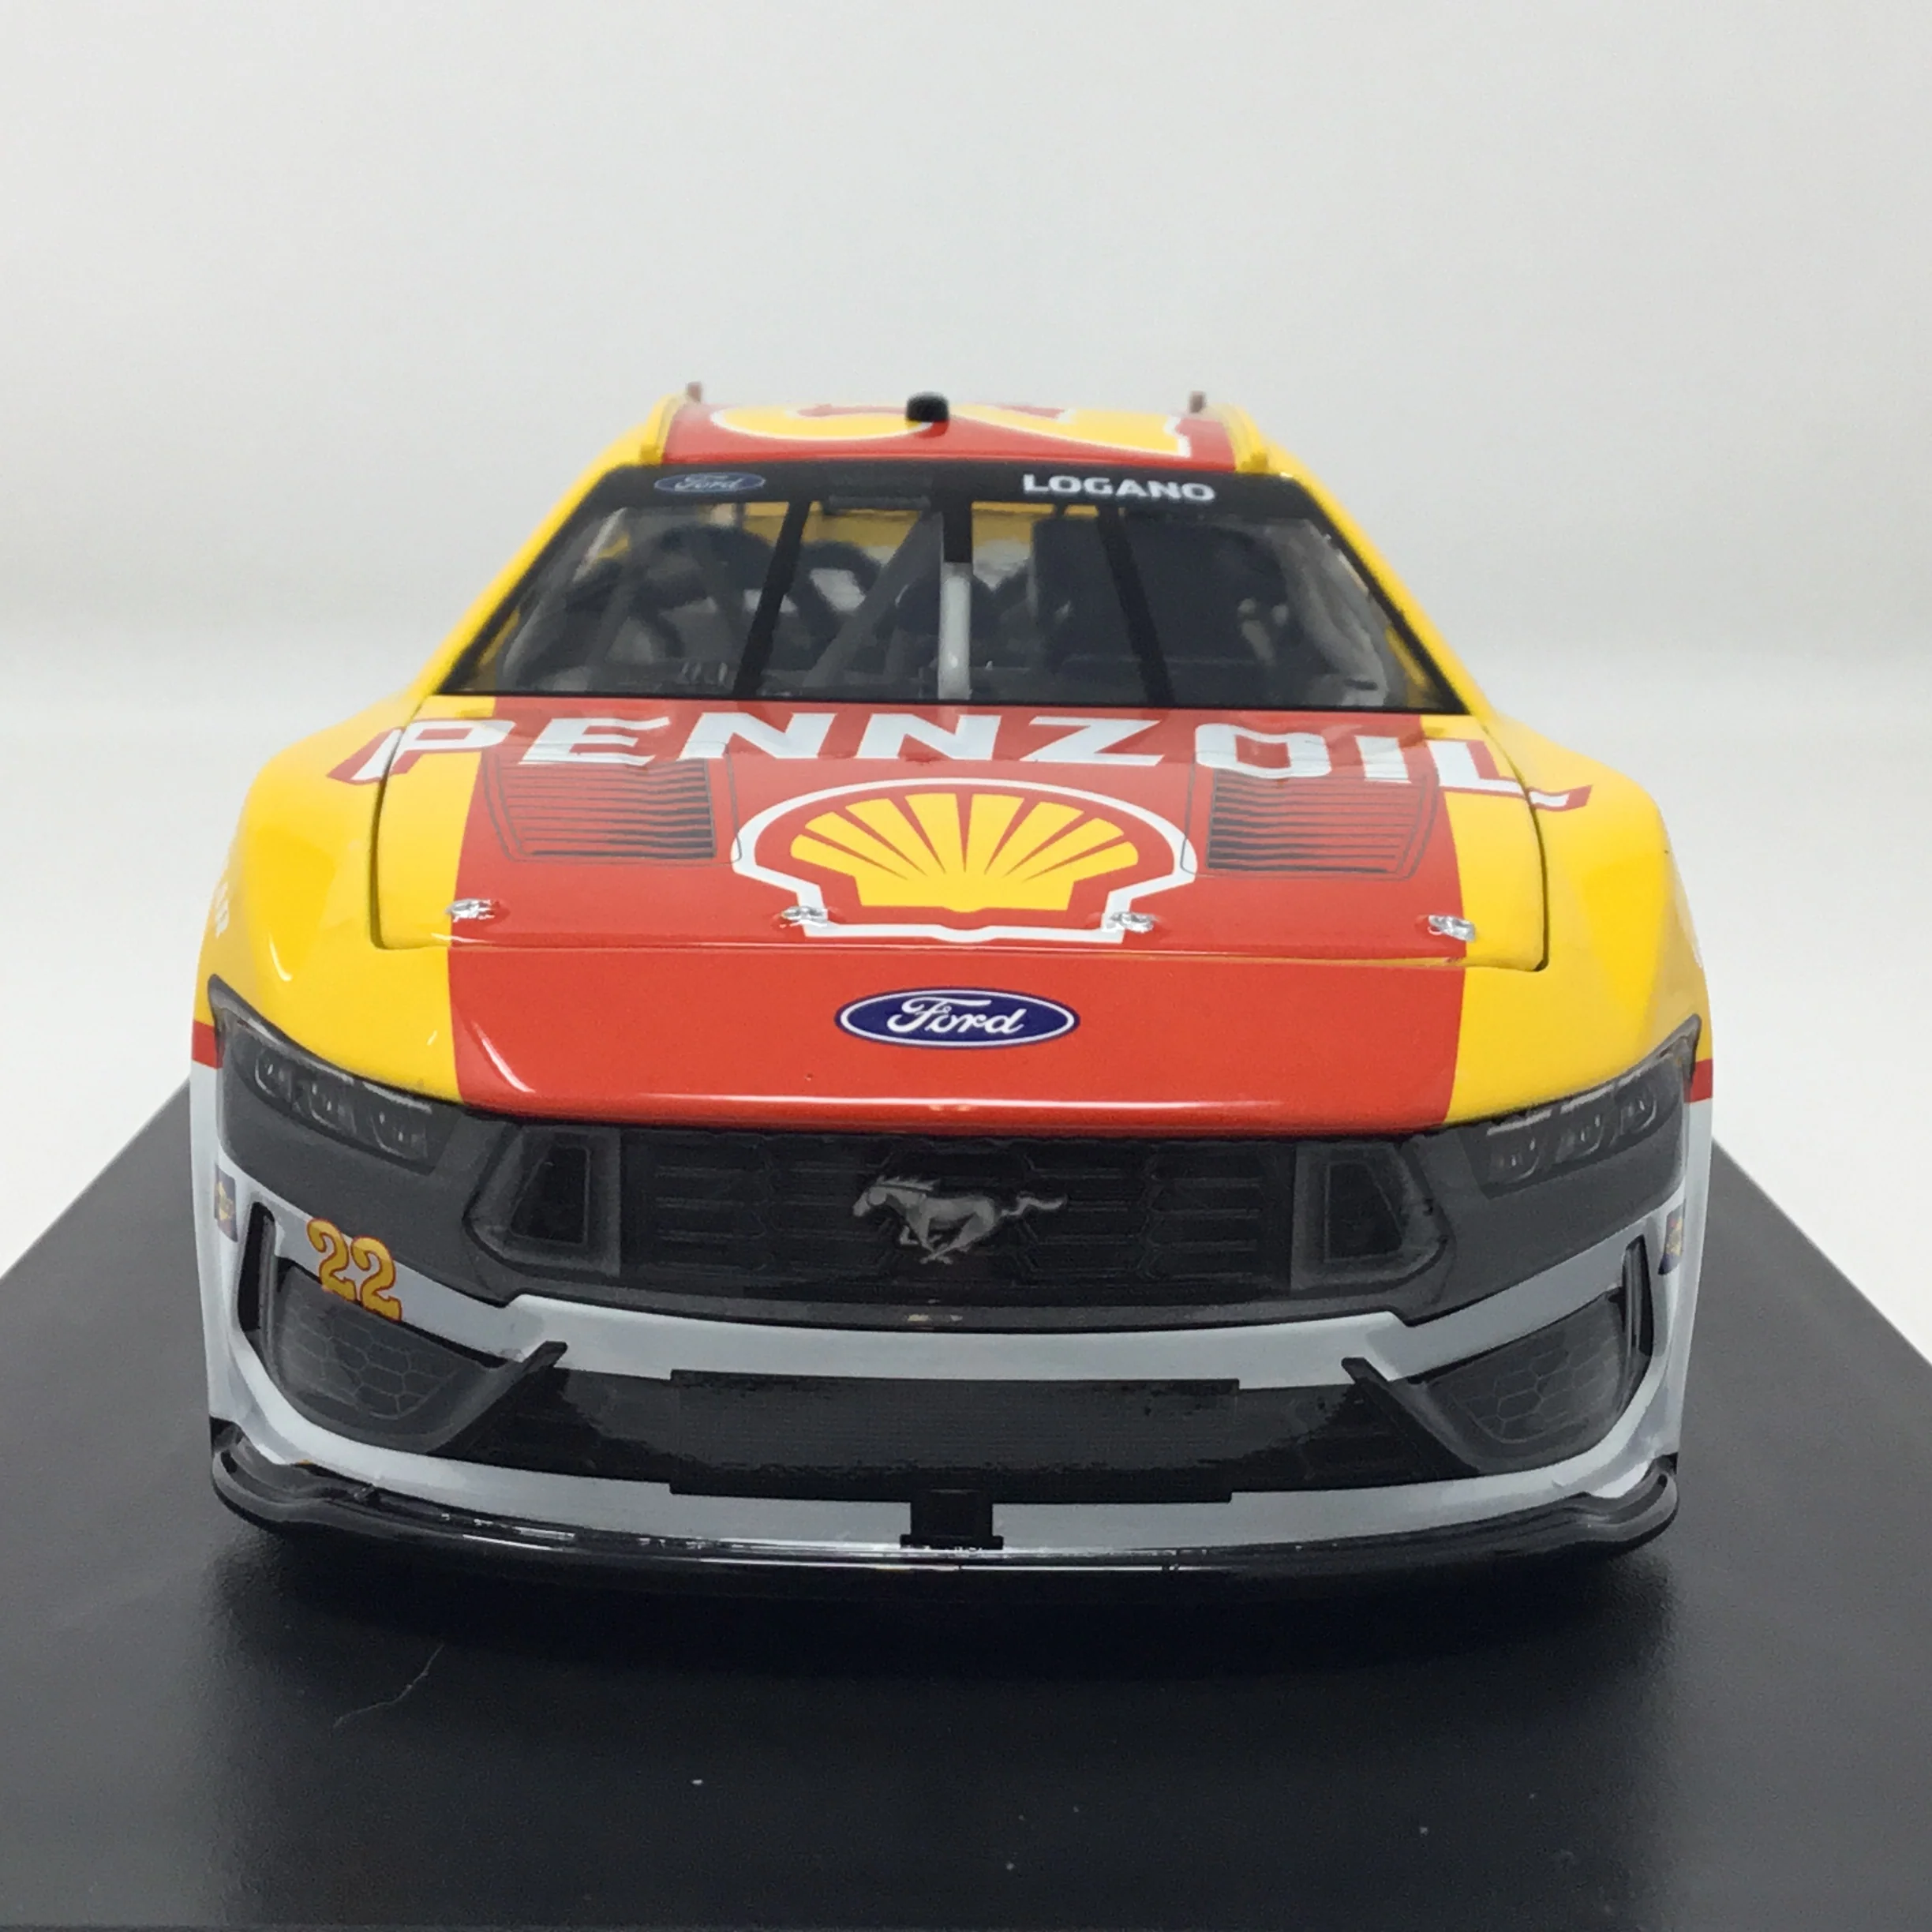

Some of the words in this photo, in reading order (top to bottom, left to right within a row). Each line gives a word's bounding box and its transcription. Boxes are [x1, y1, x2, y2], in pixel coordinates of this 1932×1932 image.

[674, 474, 744, 492] Ford
[1023, 474, 1215, 501] LOGANO
[350, 711, 1571, 807] PENNZOIL
[886, 997, 1028, 1034] Ford
[306, 1218, 402, 1322] 22
